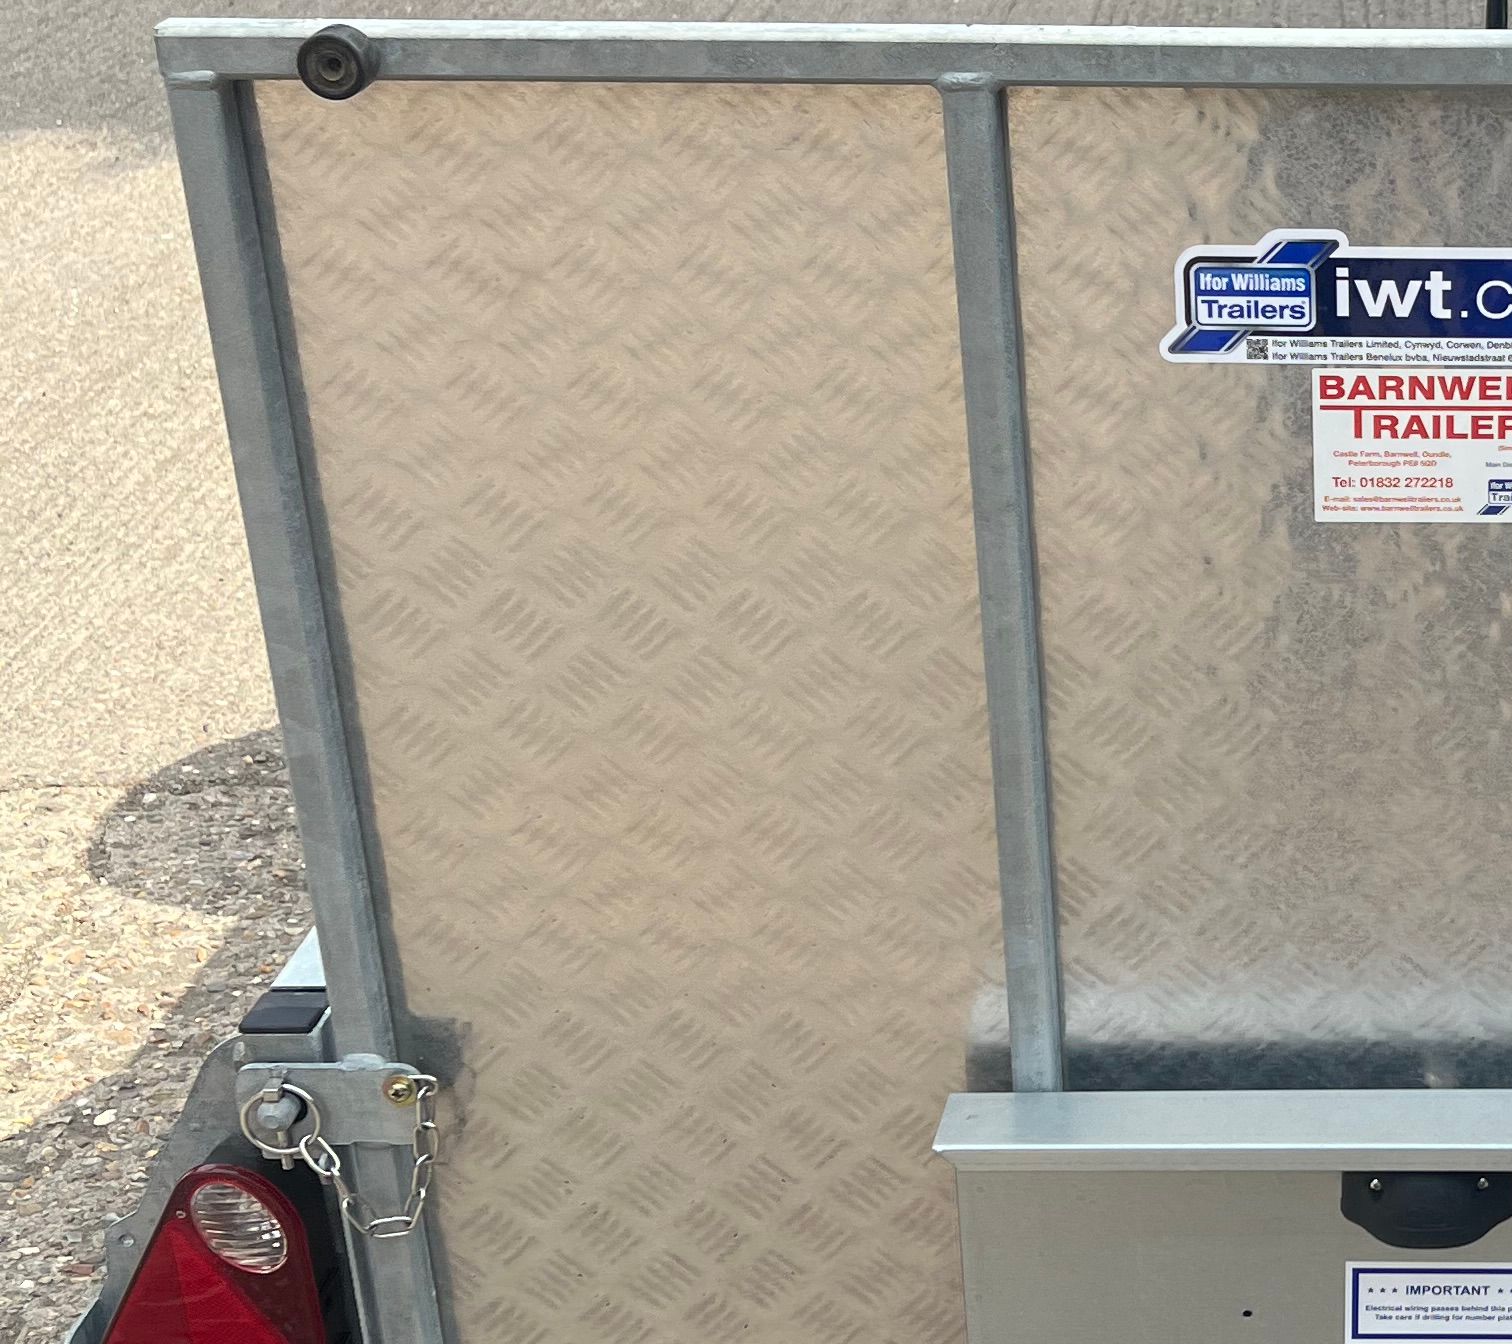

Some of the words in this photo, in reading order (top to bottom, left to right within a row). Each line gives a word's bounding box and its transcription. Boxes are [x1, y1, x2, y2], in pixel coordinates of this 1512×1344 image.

[1199, 272, 1228, 290] Ifor
[1231, 273, 1306, 291] Williams
[1201, 299, 1306, 319] Trailers
[1272, 340, 1287, 348] Ifor
[1289, 340, 1328, 348] Williams
[1331, 340, 1363, 348] Trailers
[1366, 340, 1402, 350] Limited,
[1446, 341, 1484, 350] Corwen,
[1272, 352, 1287, 361] Ifor
[1289, 352, 1328, 361] Williams
[1331, 353, 1363, 361] Trailers
[1366, 353, 1402, 362] Benelux
[1348, 459, 1401, 468] Peterborough
[1332, 477, 1355, 488] Tel:
[1360, 477, 1400, 488] 01832
[1404, 477, 1454, 488] 272218
[1405, 1285, 1491, 1296] IMPORTANT
[1404, 1305, 1429, 1313] wiring
[1431, 1305, 1459, 1313] passes
[1422, 1314, 1450, 1322] drilling
